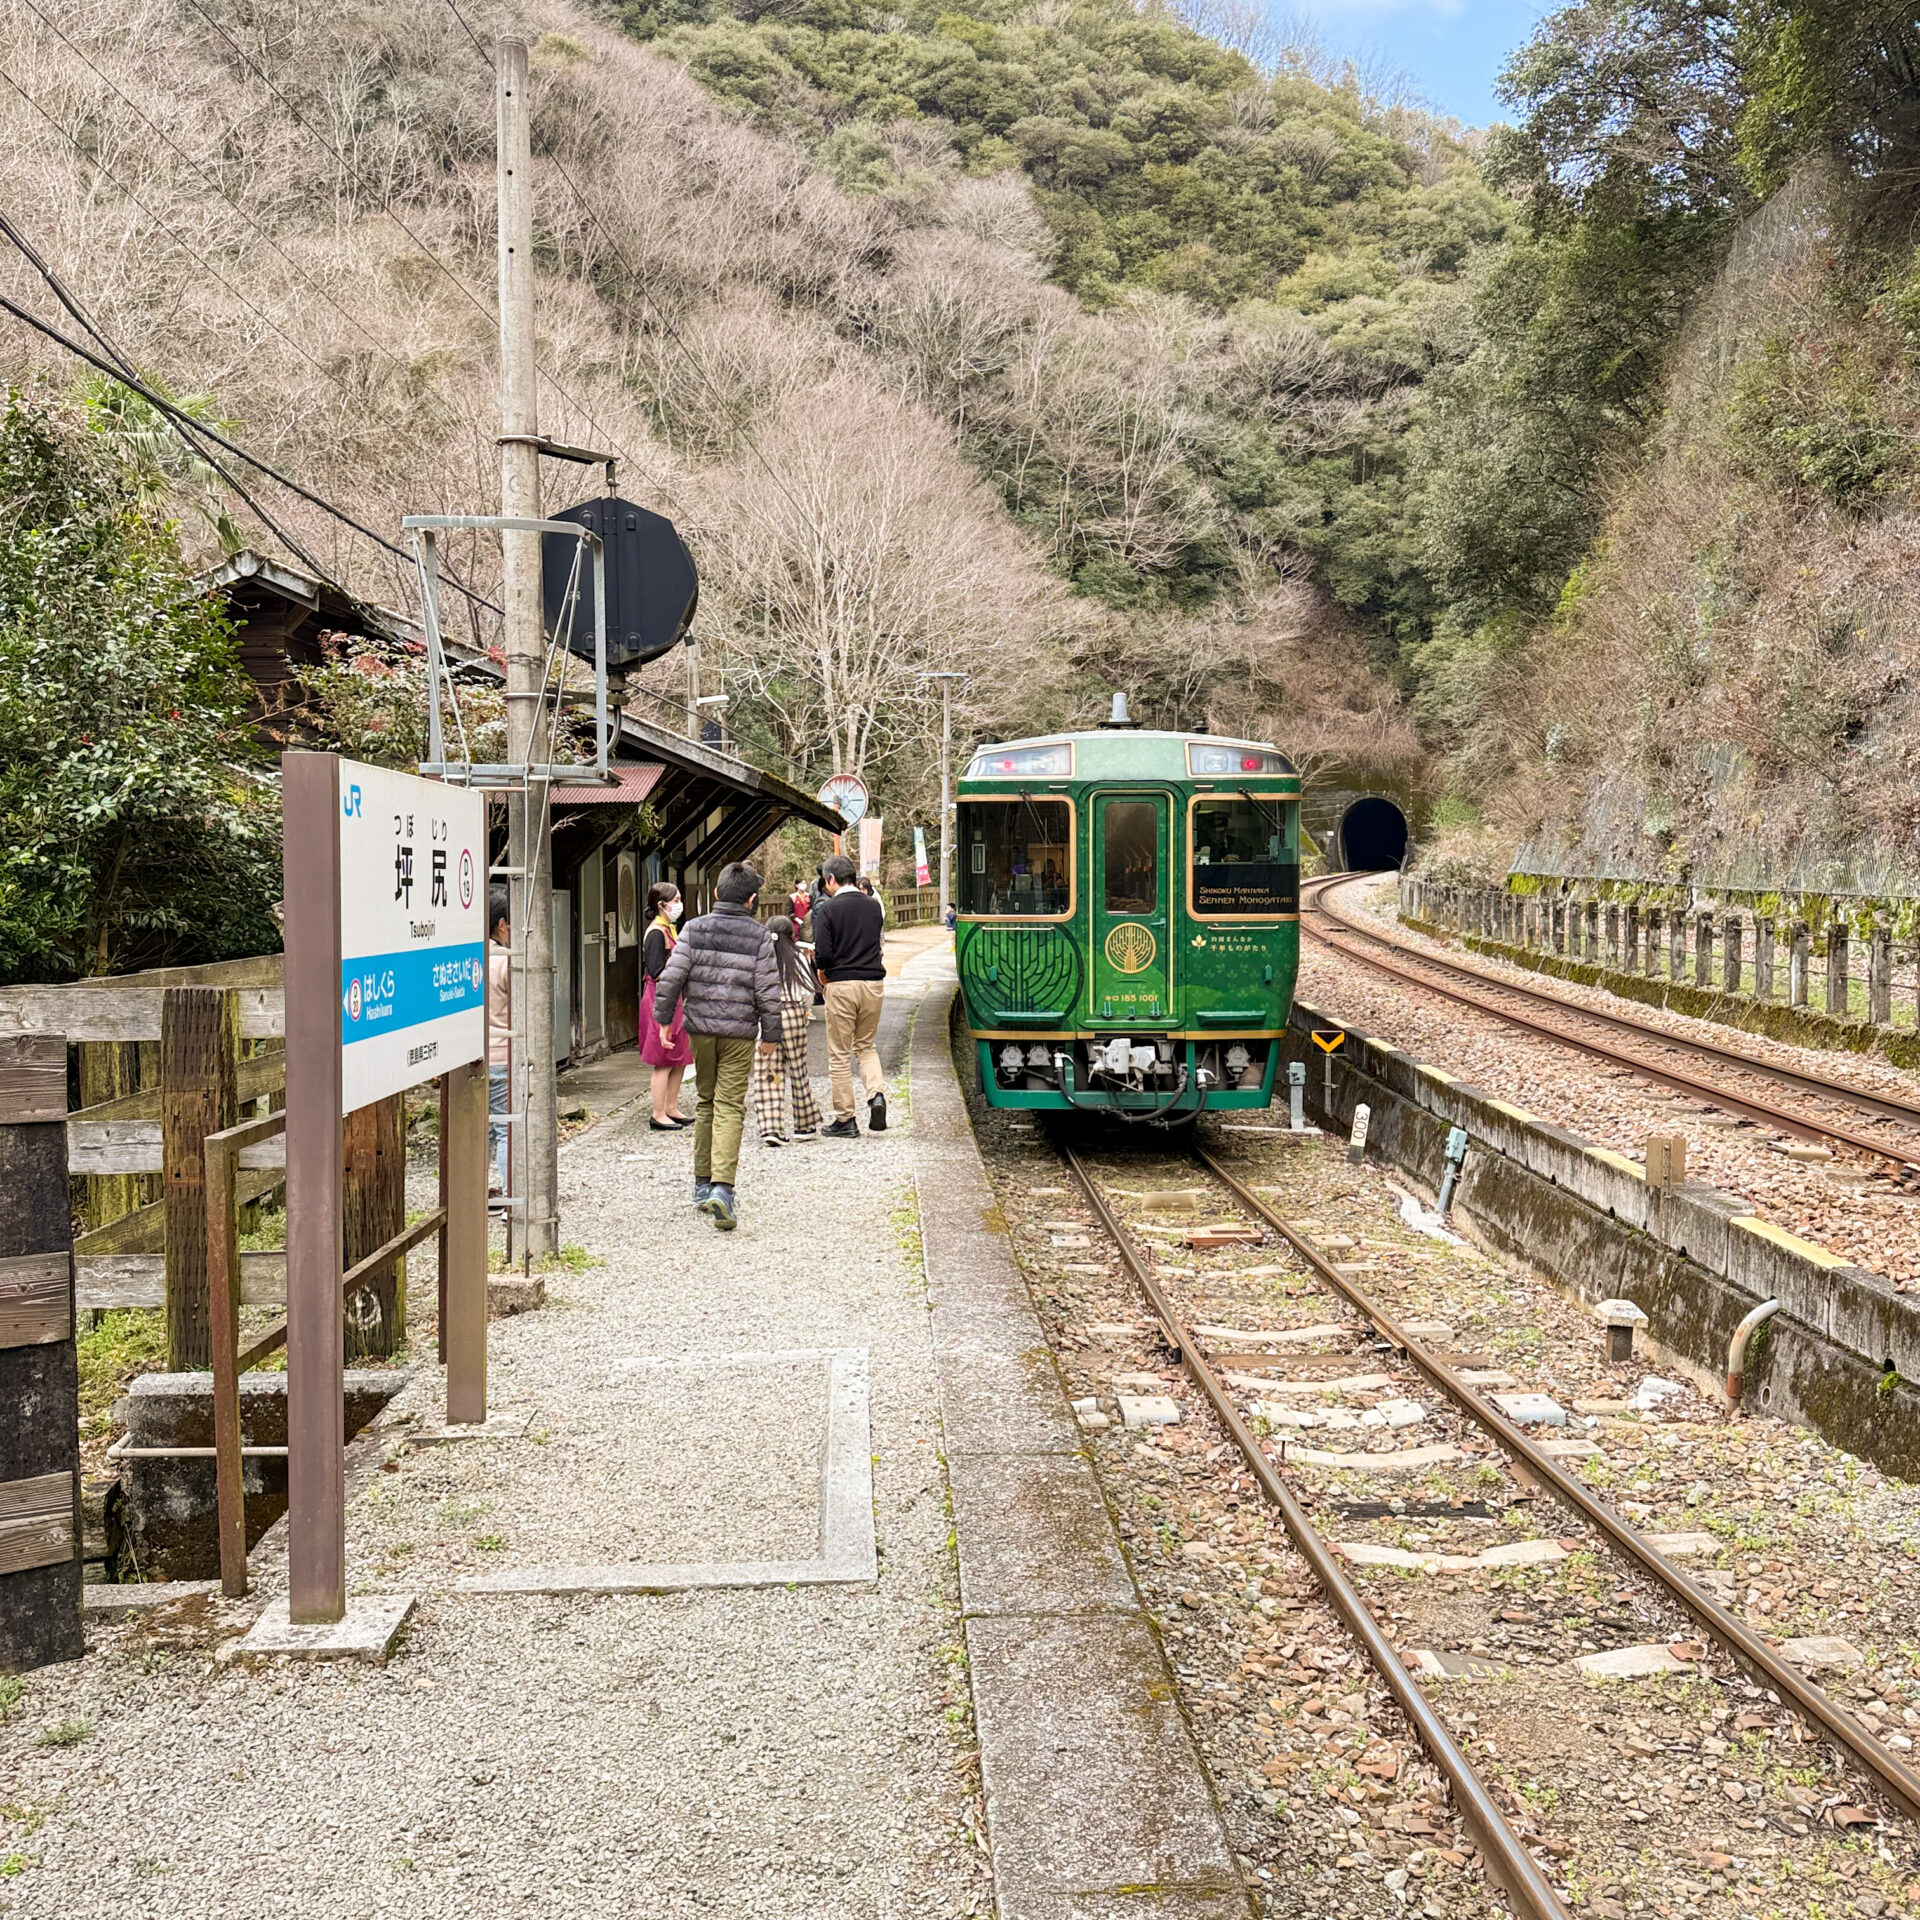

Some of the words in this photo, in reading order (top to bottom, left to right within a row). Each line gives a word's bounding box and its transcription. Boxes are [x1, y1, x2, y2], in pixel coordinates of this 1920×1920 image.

[344, 784, 362, 818] JR
[394, 814, 448, 841] つぼじり
[395, 844, 448, 910] 坪尻
[463, 858, 469, 876] D
[363, 970, 396, 1002] はしくら
[1353, 1111, 1368, 1139] 300
